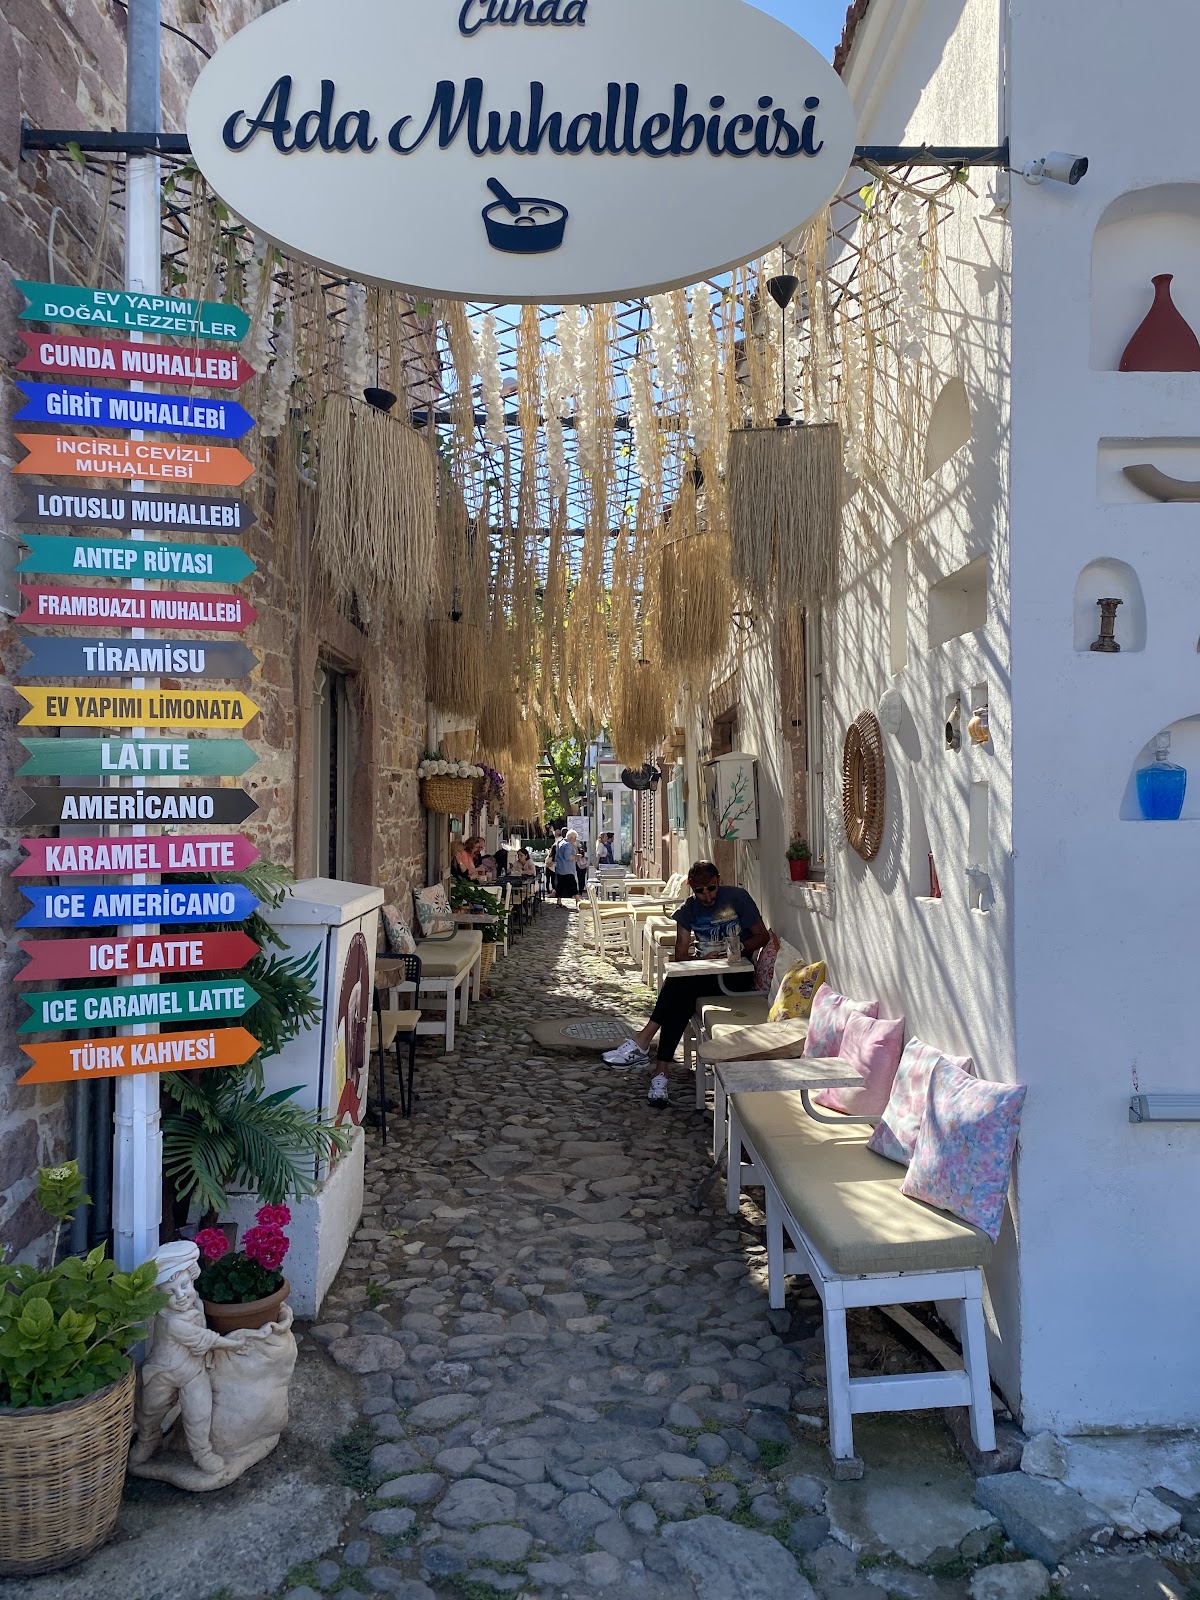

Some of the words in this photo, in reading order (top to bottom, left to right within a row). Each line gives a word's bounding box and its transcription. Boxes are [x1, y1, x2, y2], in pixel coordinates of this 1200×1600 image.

[222, 75, 378, 153] Ada
[388, 77, 823, 157] Muhallebicisi
[93, 292, 119, 307] EV
[125, 295, 192, 315] YAPIMI
[44, 303, 118, 324] DOĞAL
[124, 312, 237, 336] LEZZETLER
[40, 344, 116, 370] CUNDA
[121, 350, 238, 381] MUHALLEBİ
[47, 390, 102, 418] GİRİT
[109, 398, 226, 430] MUHALLEBİ
[56, 438, 130, 457] İNCİRLİ
[135, 445, 210, 463] CEVİZLİ
[76, 459, 193, 478] MUHALLEBİ
[38, 495, 125, 519] LOTUSLU
[131, 502, 240, 528] MUHALLEBİ
[73, 547, 138, 570] ANTEP
[144, 547, 213, 575] RÜYASI
[38, 595, 145, 619] FRAMBUAZLI
[150, 599, 241, 623] MUHALLEBİ
[83, 642, 205, 673] TİRAMİSU
[46, 696, 69, 717] EV
[75, 697, 142, 719] YAPIMI
[149, 694, 243, 720] LİMONATA
[101, 743, 189, 770] LATTE
[60, 790, 214, 820] AMERİCANO
[46, 844, 161, 872] KARAMEL
[168, 842, 235, 868] LATTE
[45, 895, 85, 918] ICE
[92, 889, 235, 918] AMERİCANO
[90, 944, 129, 971] ICE
[136, 941, 203, 969] LATTE
[42, 999, 77, 1023] ICE
[84, 991, 182, 1019] CARAMEL
[189, 987, 245, 1012] LATTE
[69, 1043, 125, 1071] TÜRK
[131, 1033, 216, 1066] KAHVESİ
